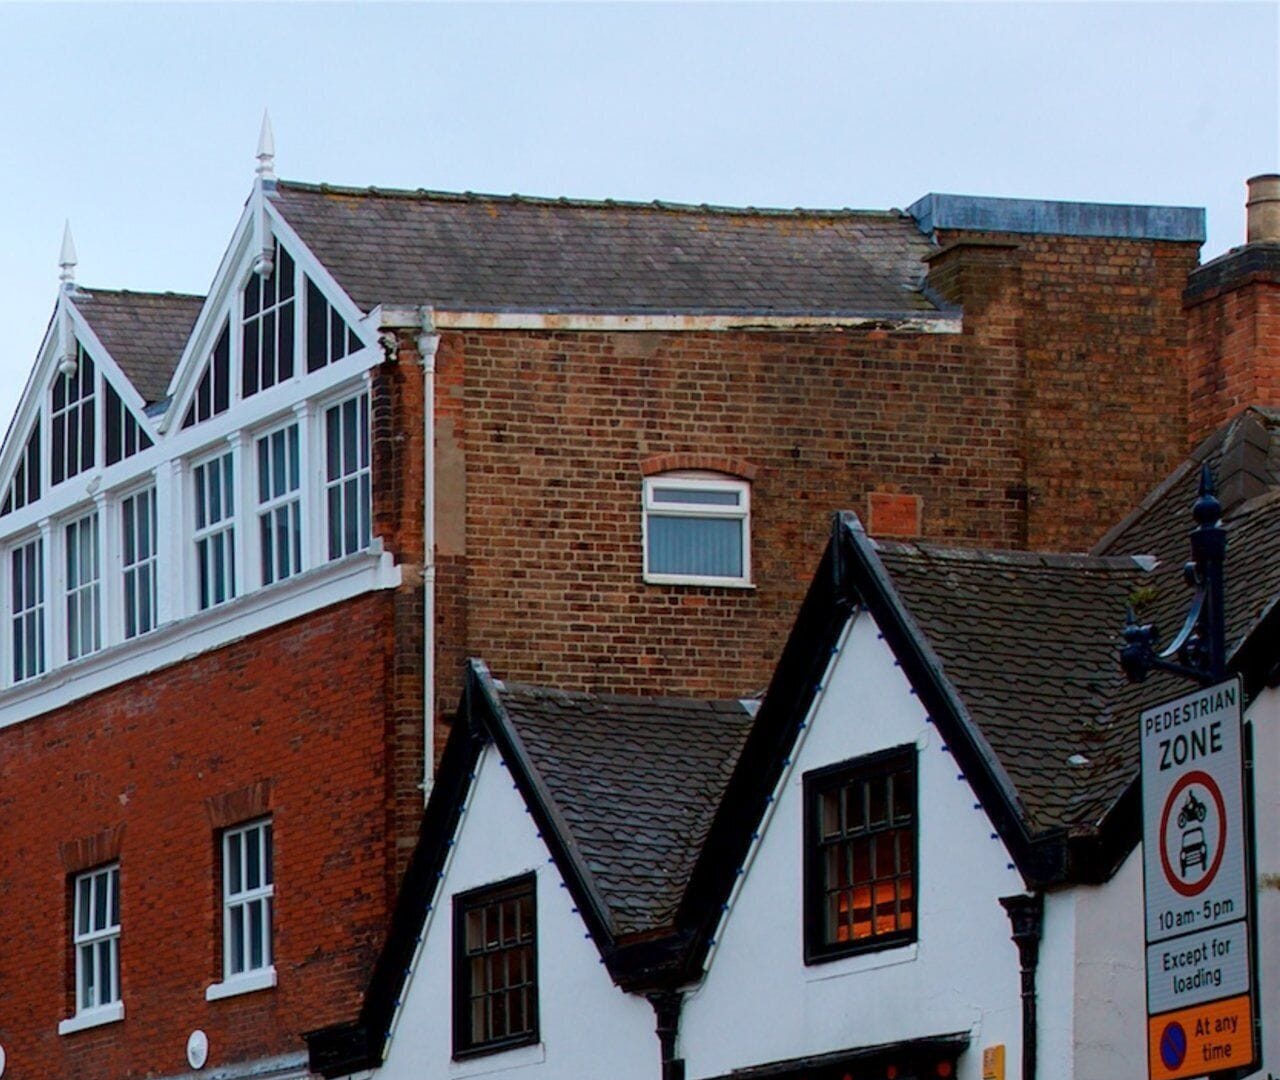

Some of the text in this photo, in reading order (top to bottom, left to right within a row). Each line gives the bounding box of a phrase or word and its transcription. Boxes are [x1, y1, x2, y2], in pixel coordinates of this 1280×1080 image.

[1145, 687, 1235, 737] PEDESTRIAN
[1159, 721, 1223, 772] ZONE
[1163, 938, 1231, 972] Except for
[1173, 967, 1221, 994] loading
[1195, 1015, 1238, 1037] At any
[1202, 1042, 1232, 1062] time
